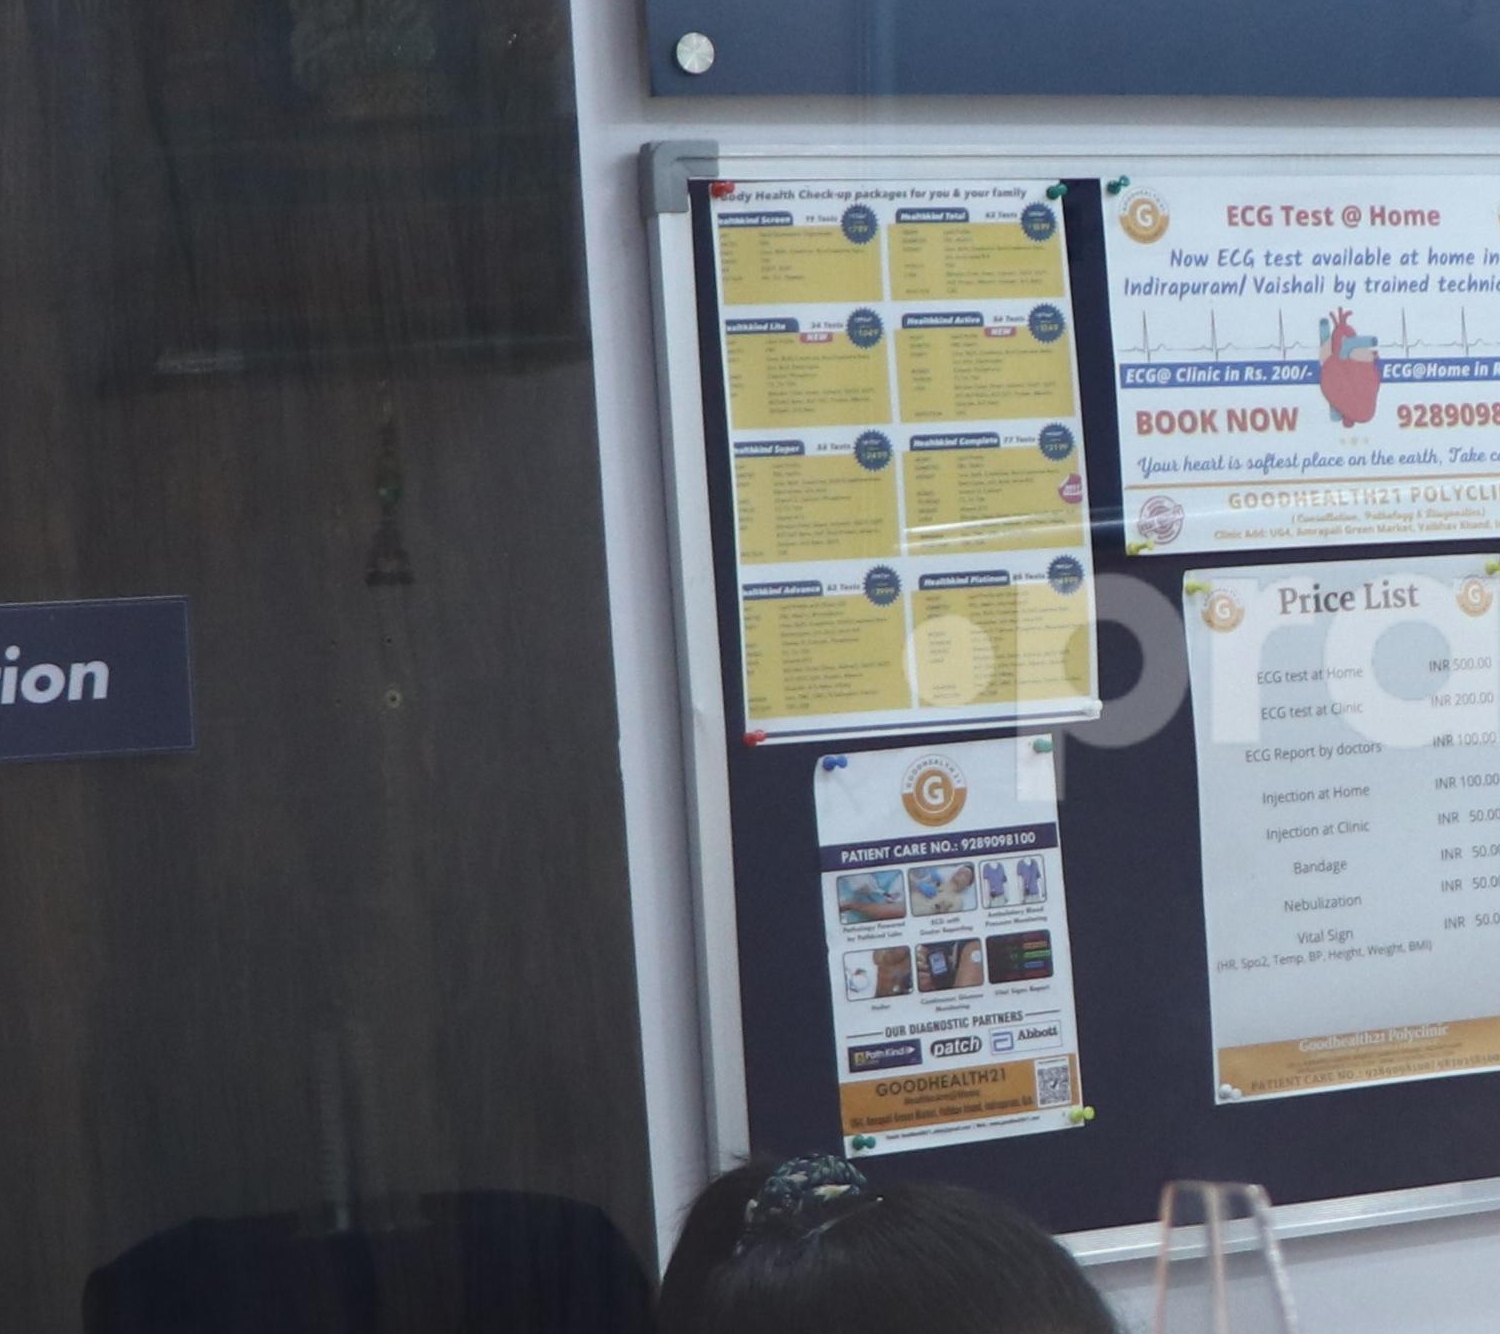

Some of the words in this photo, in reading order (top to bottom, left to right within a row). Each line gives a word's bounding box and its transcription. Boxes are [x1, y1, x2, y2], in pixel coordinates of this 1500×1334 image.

[1227, 205, 1273, 228] ECG
[1281, 205, 1334, 227] Test
[1342, 205, 1362, 228] @
[1369, 205, 1441, 227] Home
[1170, 248, 1209, 267] Now
[1217, 249, 1255, 268] ECG
[1264, 248, 1303, 267] test
[1312, 246, 1391, 267] available
[1399, 248, 1419, 265] at
[1427, 247, 1475, 265] home
[1483, 247, 1500, 265] in
[1124, 274, 1247, 301] Indirapuram/
[1253, 274, 1325, 295] Vaishali
[1334, 274, 1356, 299] by
[1364, 274, 1430, 293] trained
[1125, 367, 1171, 384] ECG@
[1176, 366, 1220, 383] Clinic
[1224, 366, 1240, 381] in
[1244, 366, 1267, 381] Rs.
[1271, 365, 1313, 381] 200/-
[1382, 362, 1470, 378] ECG@Home
[1474, 361, 1488, 376] in
[1135, 409, 1219, 436] BOOK
[1226, 407, 1299, 433] NOW
[1278, 582, 1356, 615] Price
[1363, 580, 1420, 610] List
[1257, 671, 1283, 685] ECG
[1285, 668, 1308, 683] test
[1311, 668, 1323, 681] at
[1326, 666, 1364, 680] Home
[1428, 659, 1450, 673] INR
[1452, 656, 1493, 671] 500.00
[1245, 748, 1271, 763] ECG
[1274, 745, 1315, 764] Report
[1318, 744, 1334, 761] by
[1336, 741, 1382, 757] doctors
[1262, 790, 1315, 806] Injection
[1317, 787, 1330, 800] at
[1332, 785, 1370, 799] Home
[1435, 776, 1457, 790] INR
[1461, 773, 1500, 788] 100.00
[841, 846, 890, 864] PATIENT
[893, 842, 927, 858] CARE
[930, 839, 959, 854] NO.:
[961, 831, 1037, 852] 9289098100
[1293, 858, 1348, 877] Bandage
[1284, 894, 1362, 913] Nebulization
[1296, 929, 1325, 945] Vital
[1328, 927, 1355, 944] Sign
[884, 1025, 906, 1038] OUR
[909, 1019, 969, 1036] DIAGNOSTIC
[972, 1011, 1024, 1027] PARTNERS
[1017, 1026, 1058, 1041] Abbott
[934, 1036, 980, 1057] patch
[875, 1069, 1007, 1097] GOODHEALTH21
